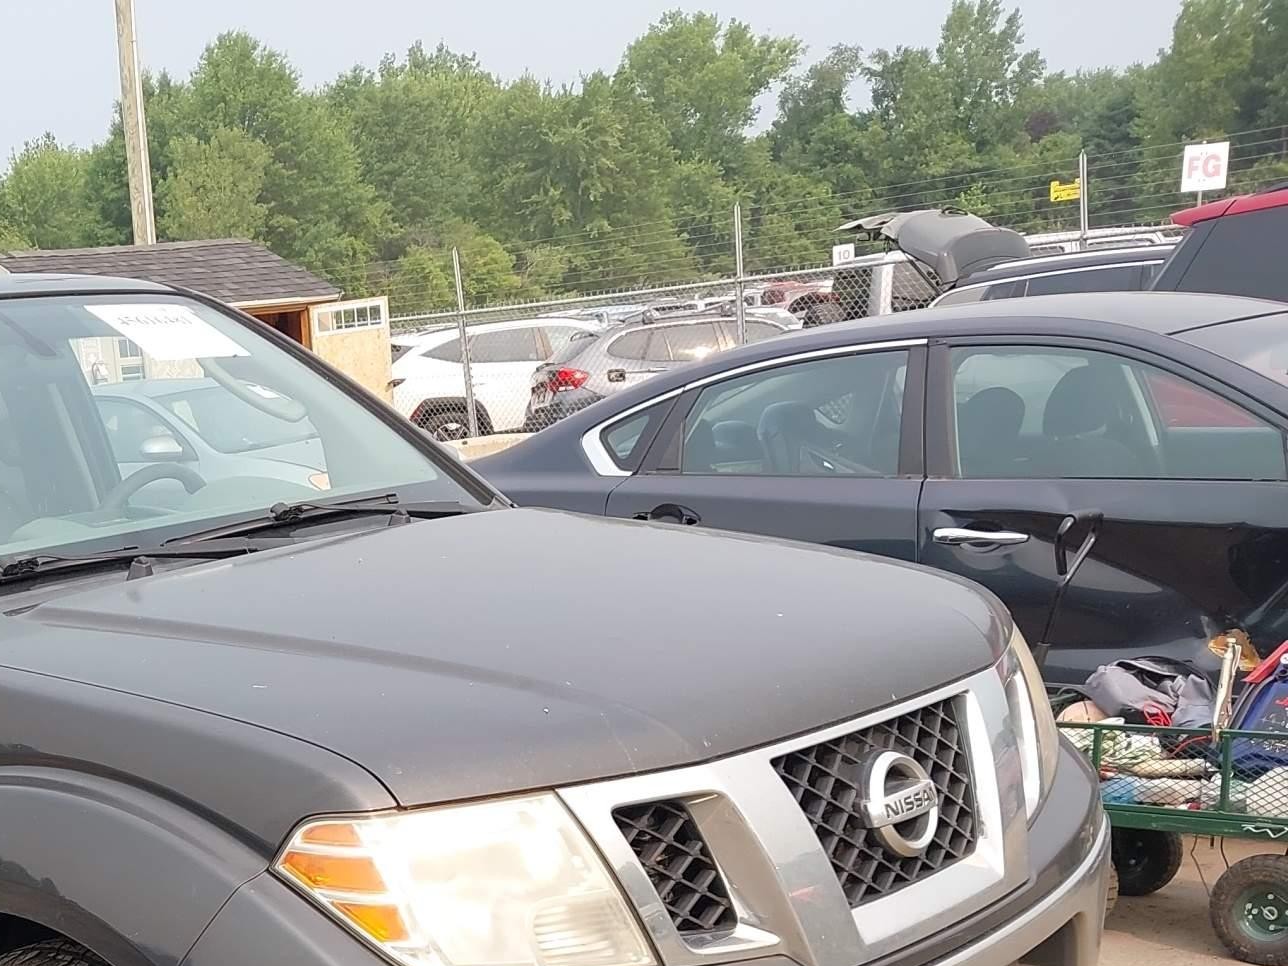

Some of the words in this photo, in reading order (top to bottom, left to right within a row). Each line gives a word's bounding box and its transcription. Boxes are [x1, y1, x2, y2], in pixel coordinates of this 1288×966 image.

[1186, 153, 1222, 179] FG
[837, 249, 851, 261] 10
[884, 786, 937, 819] NISSAN
